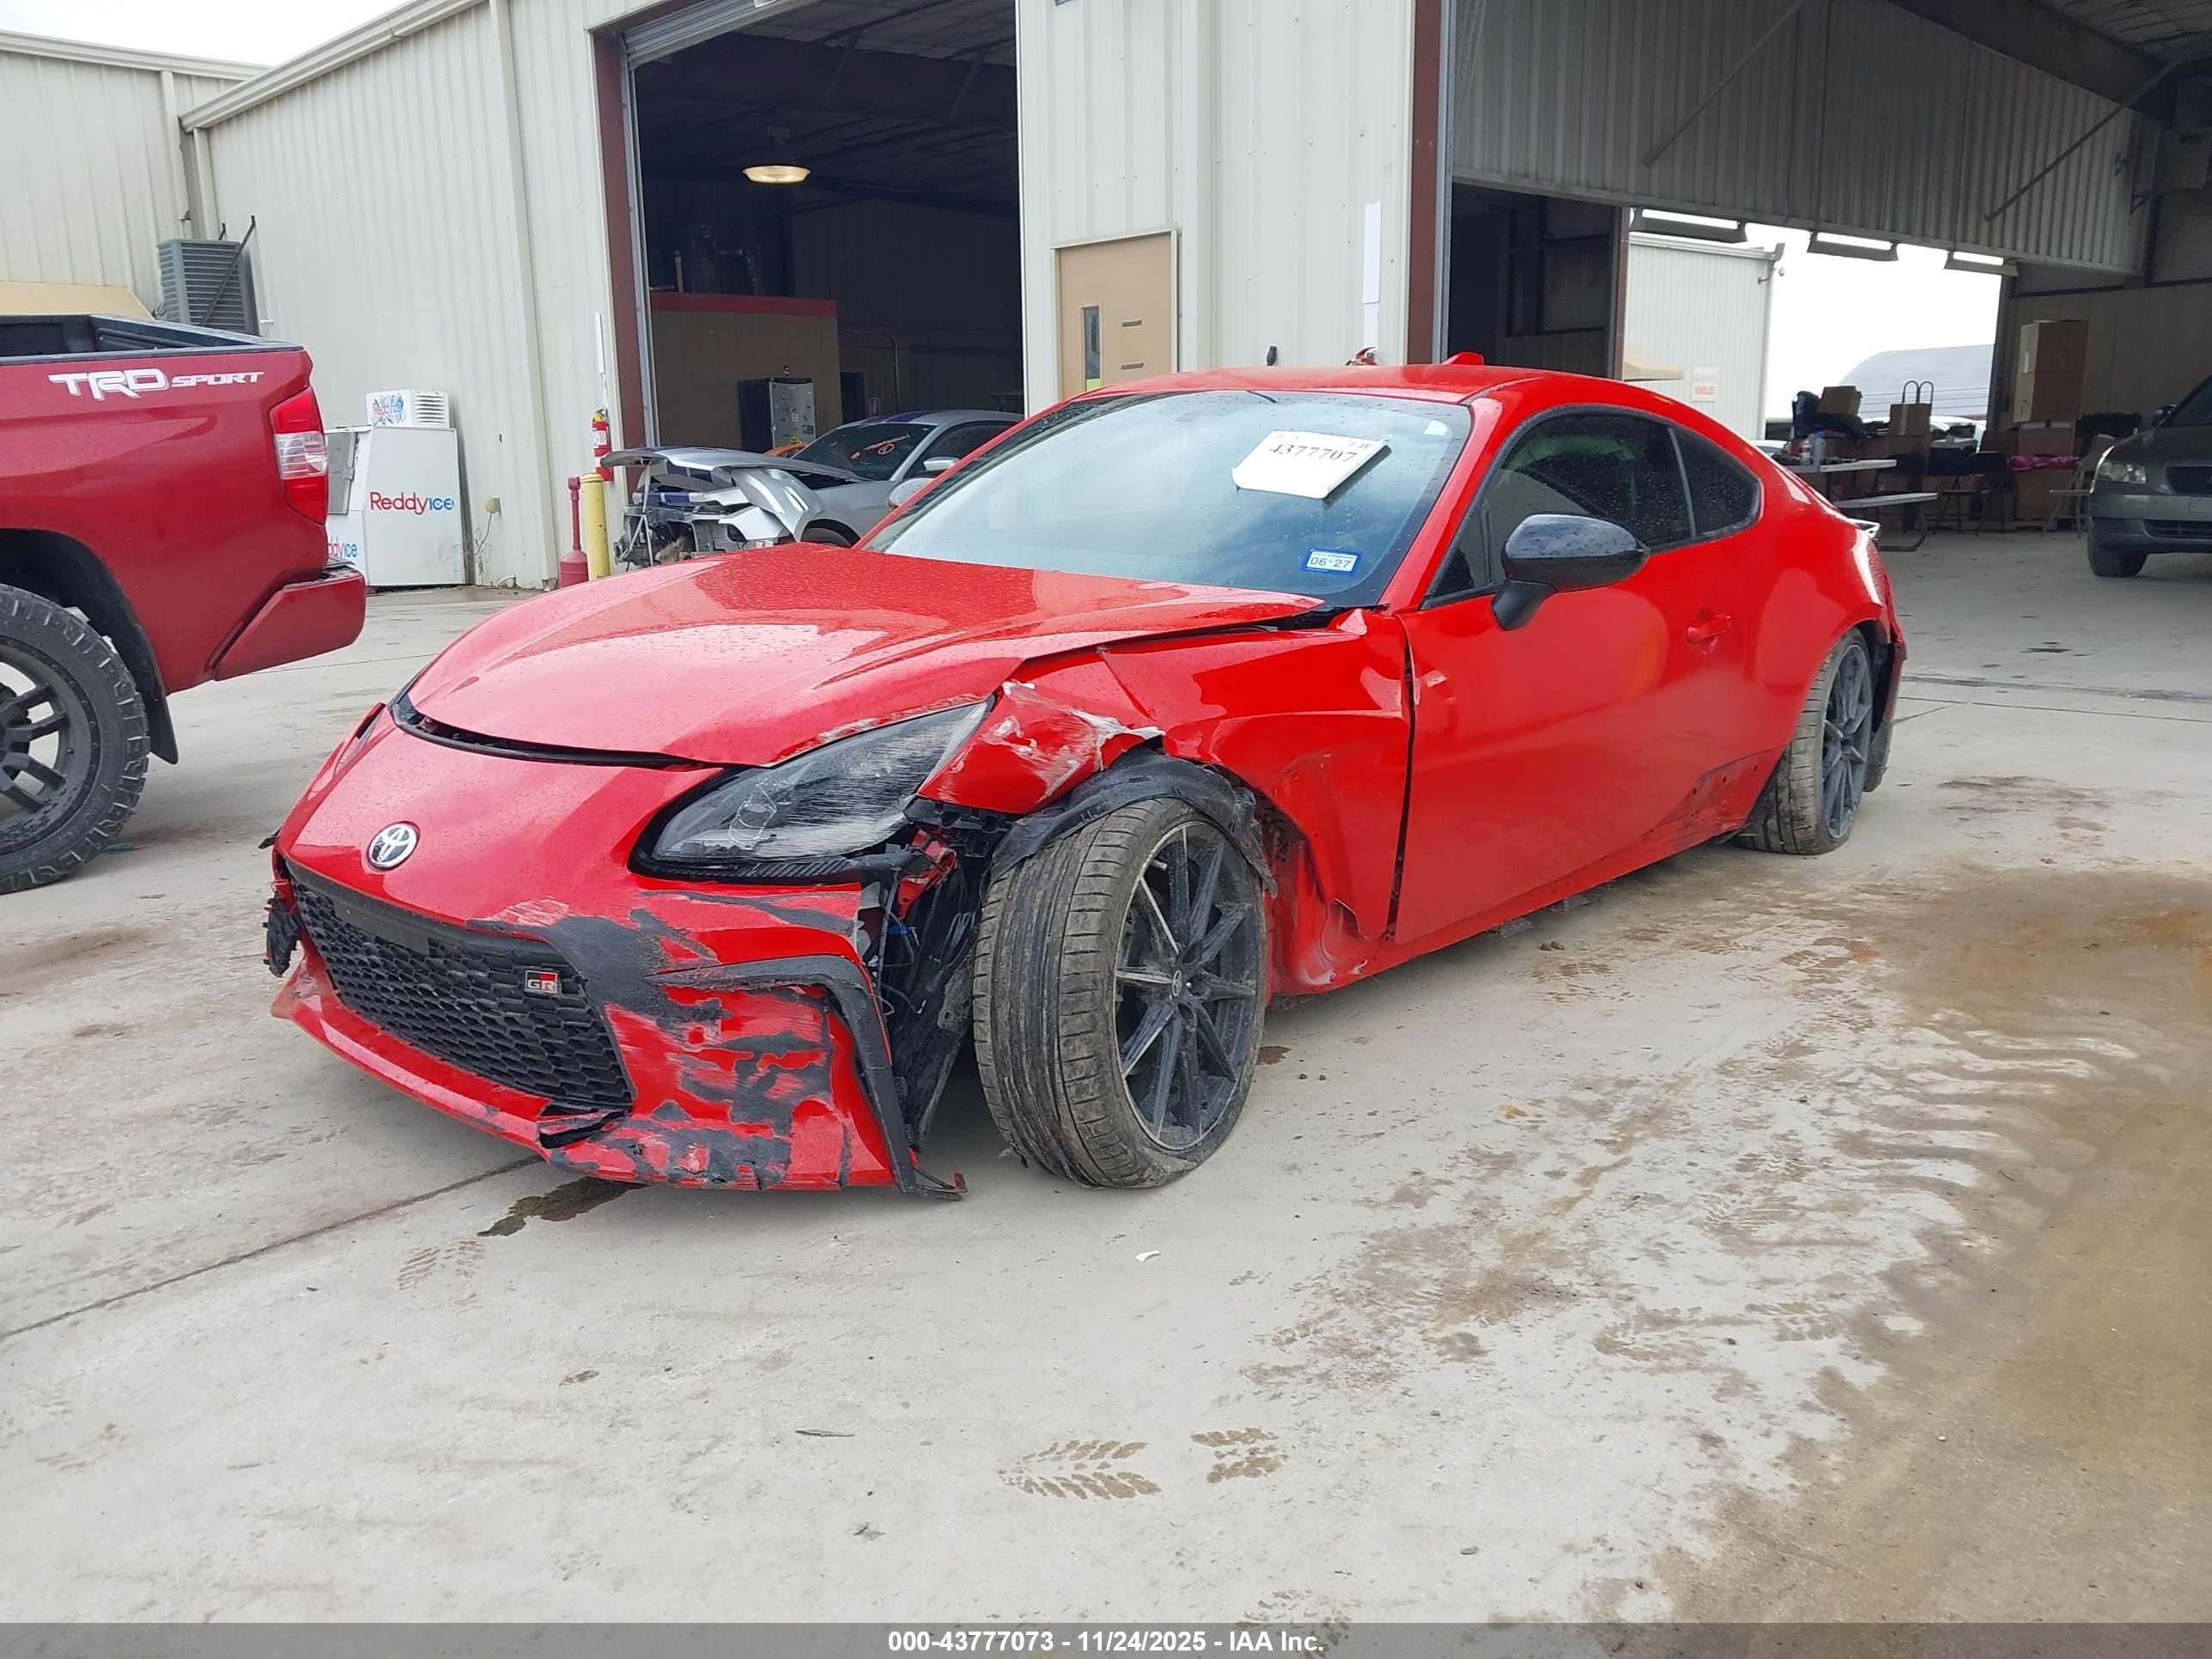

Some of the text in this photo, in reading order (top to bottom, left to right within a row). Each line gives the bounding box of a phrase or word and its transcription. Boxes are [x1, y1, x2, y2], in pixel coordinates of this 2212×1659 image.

[48, 368, 264, 401] TRD SPORT
[527, 979, 556, 990] GR
